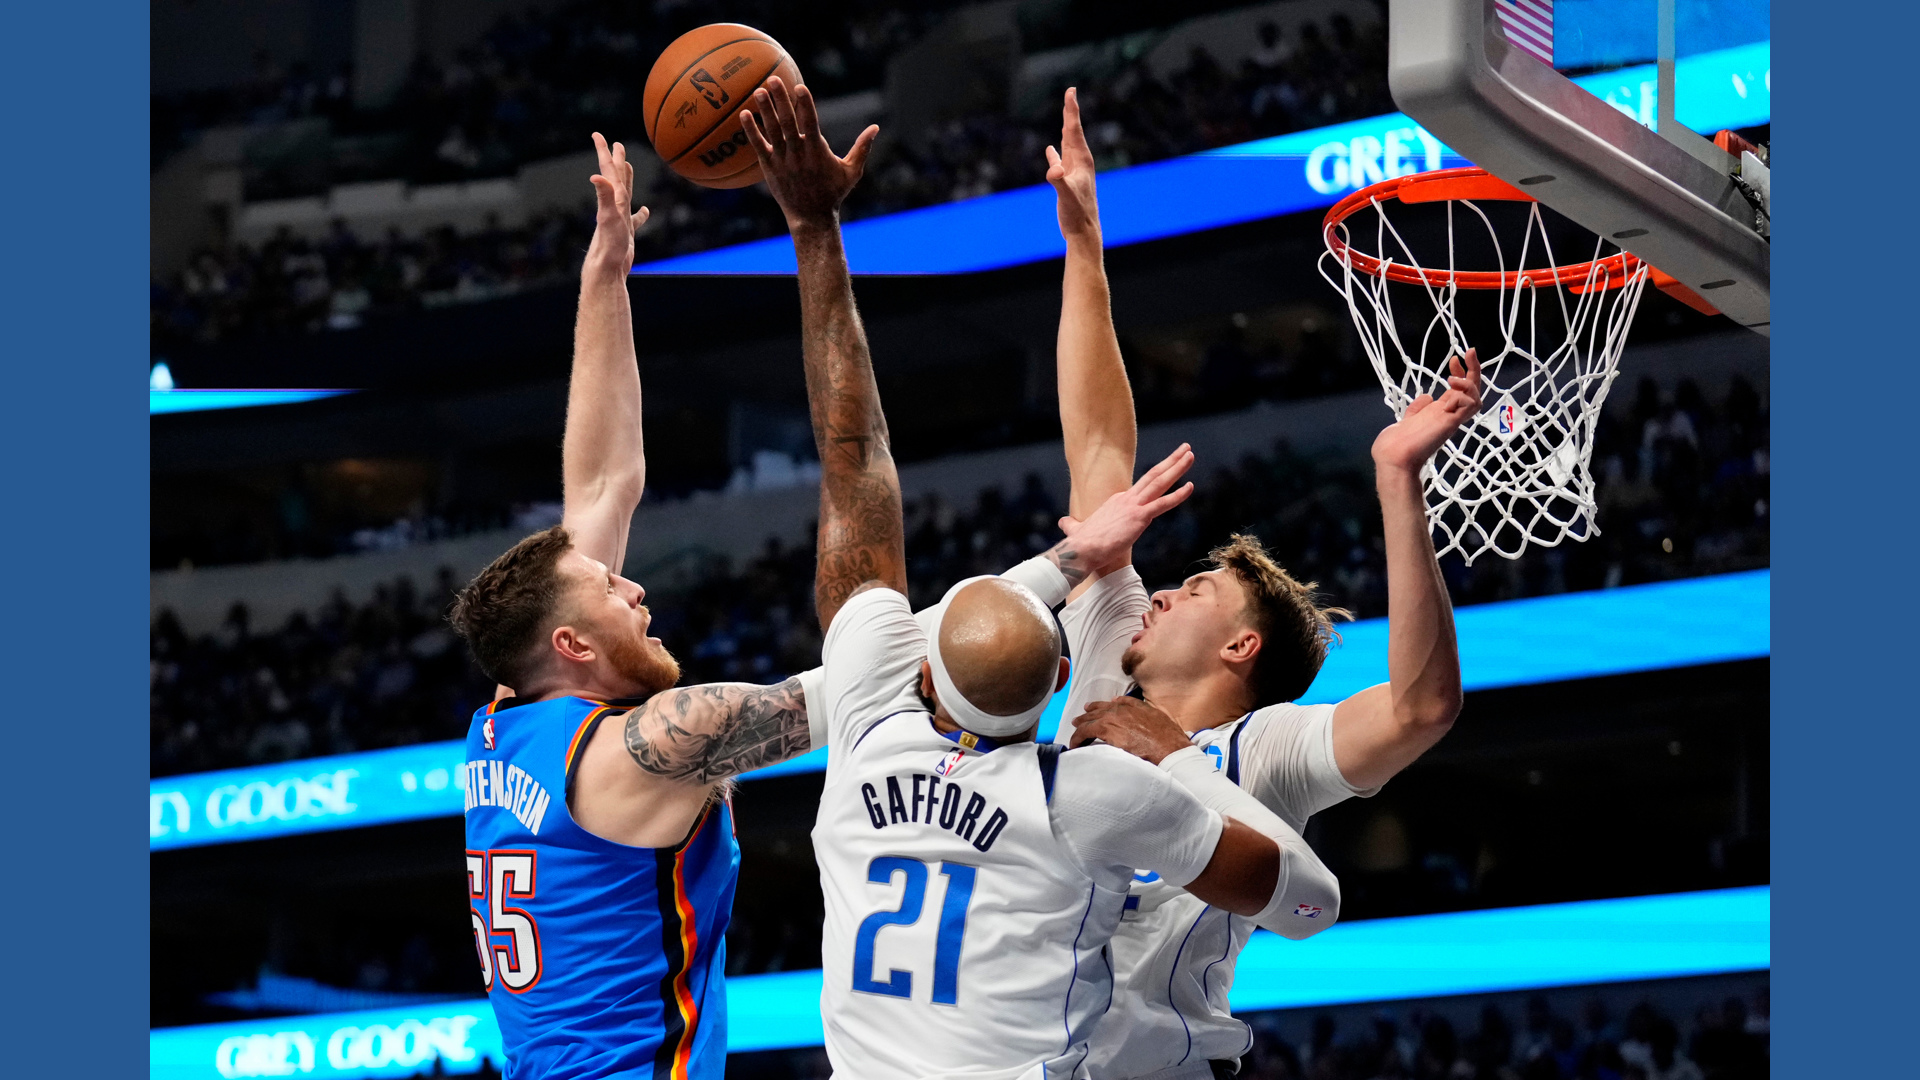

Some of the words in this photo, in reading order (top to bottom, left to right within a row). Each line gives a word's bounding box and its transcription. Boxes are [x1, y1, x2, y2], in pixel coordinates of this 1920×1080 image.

[1306, 125, 1442, 195] GREY
[150, 791, 190, 837] EY
[205, 768, 360, 829] GOOSE
[464, 759, 551, 836] RTENSTEIN
[861, 773, 1009, 853] GAFFORD
[850, 854, 980, 1008] 21
